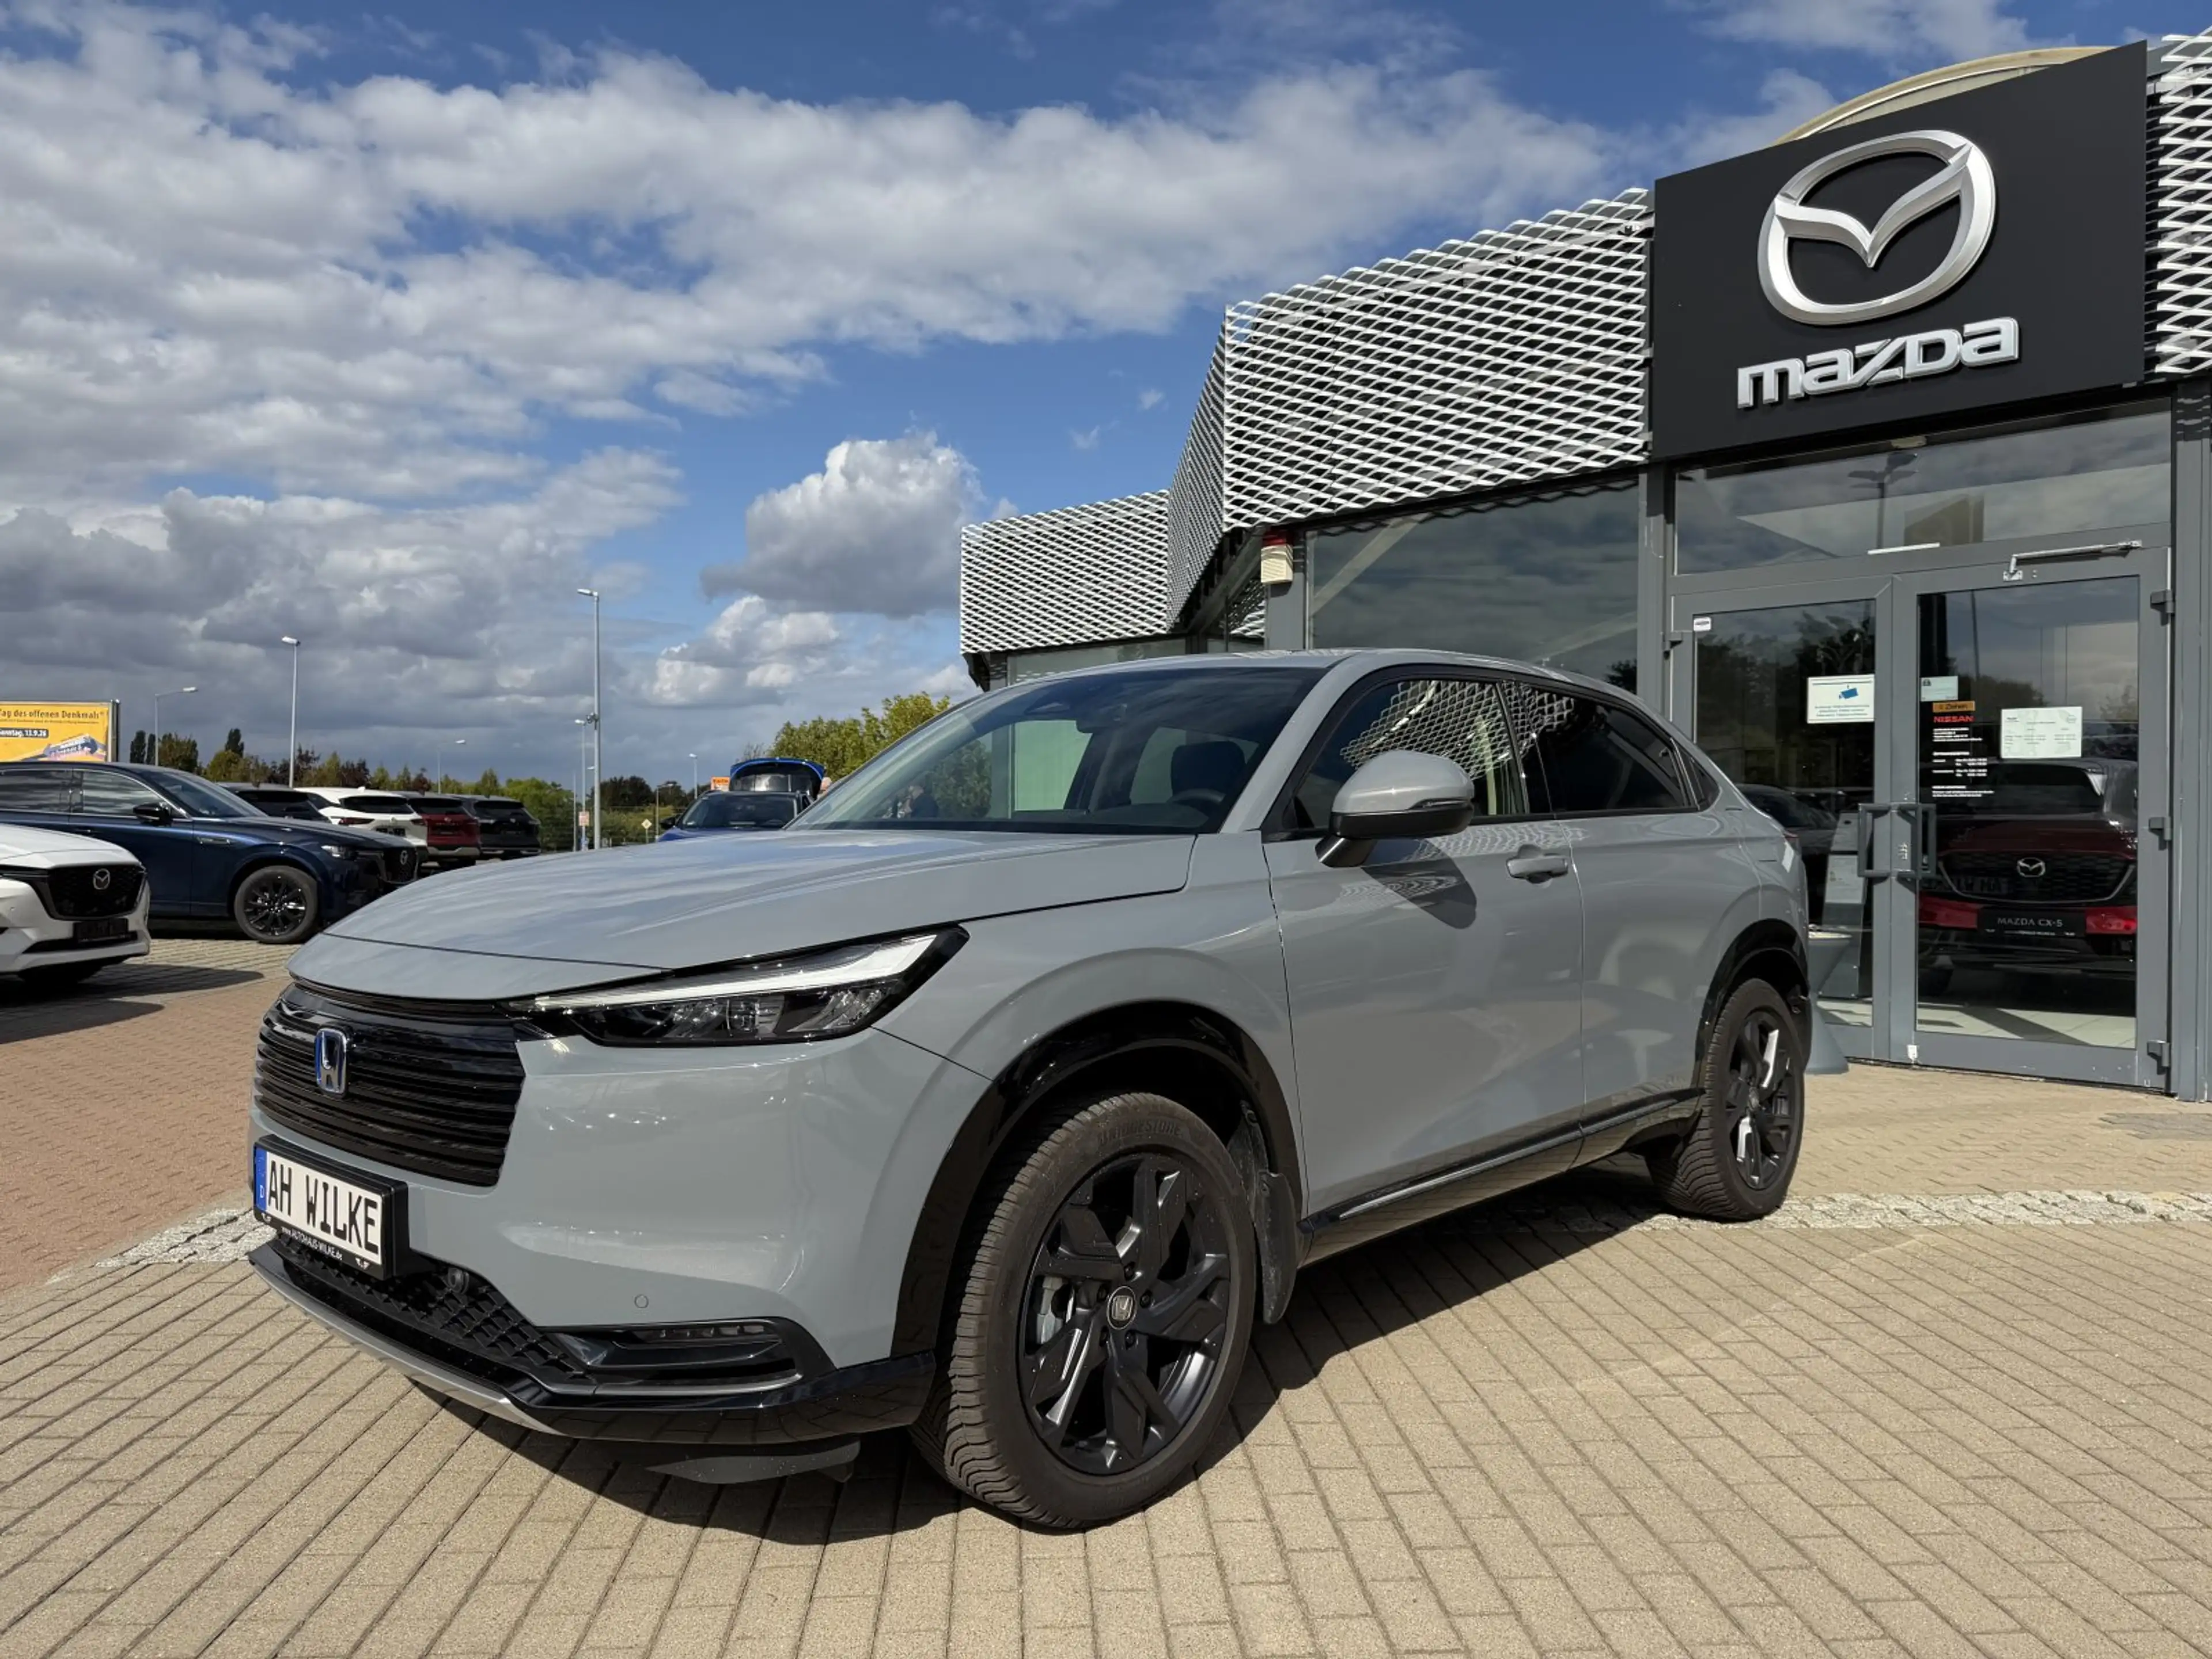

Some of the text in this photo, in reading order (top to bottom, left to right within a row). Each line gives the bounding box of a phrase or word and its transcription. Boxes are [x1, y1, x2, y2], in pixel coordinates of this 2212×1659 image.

[14, 709, 26, 717] des
[29, 709, 59, 718] offenen
[1997, 917, 2035, 926] MAZDA
[268, 1160, 292, 1217] AH
[305, 1174, 379, 1255] WILKE
